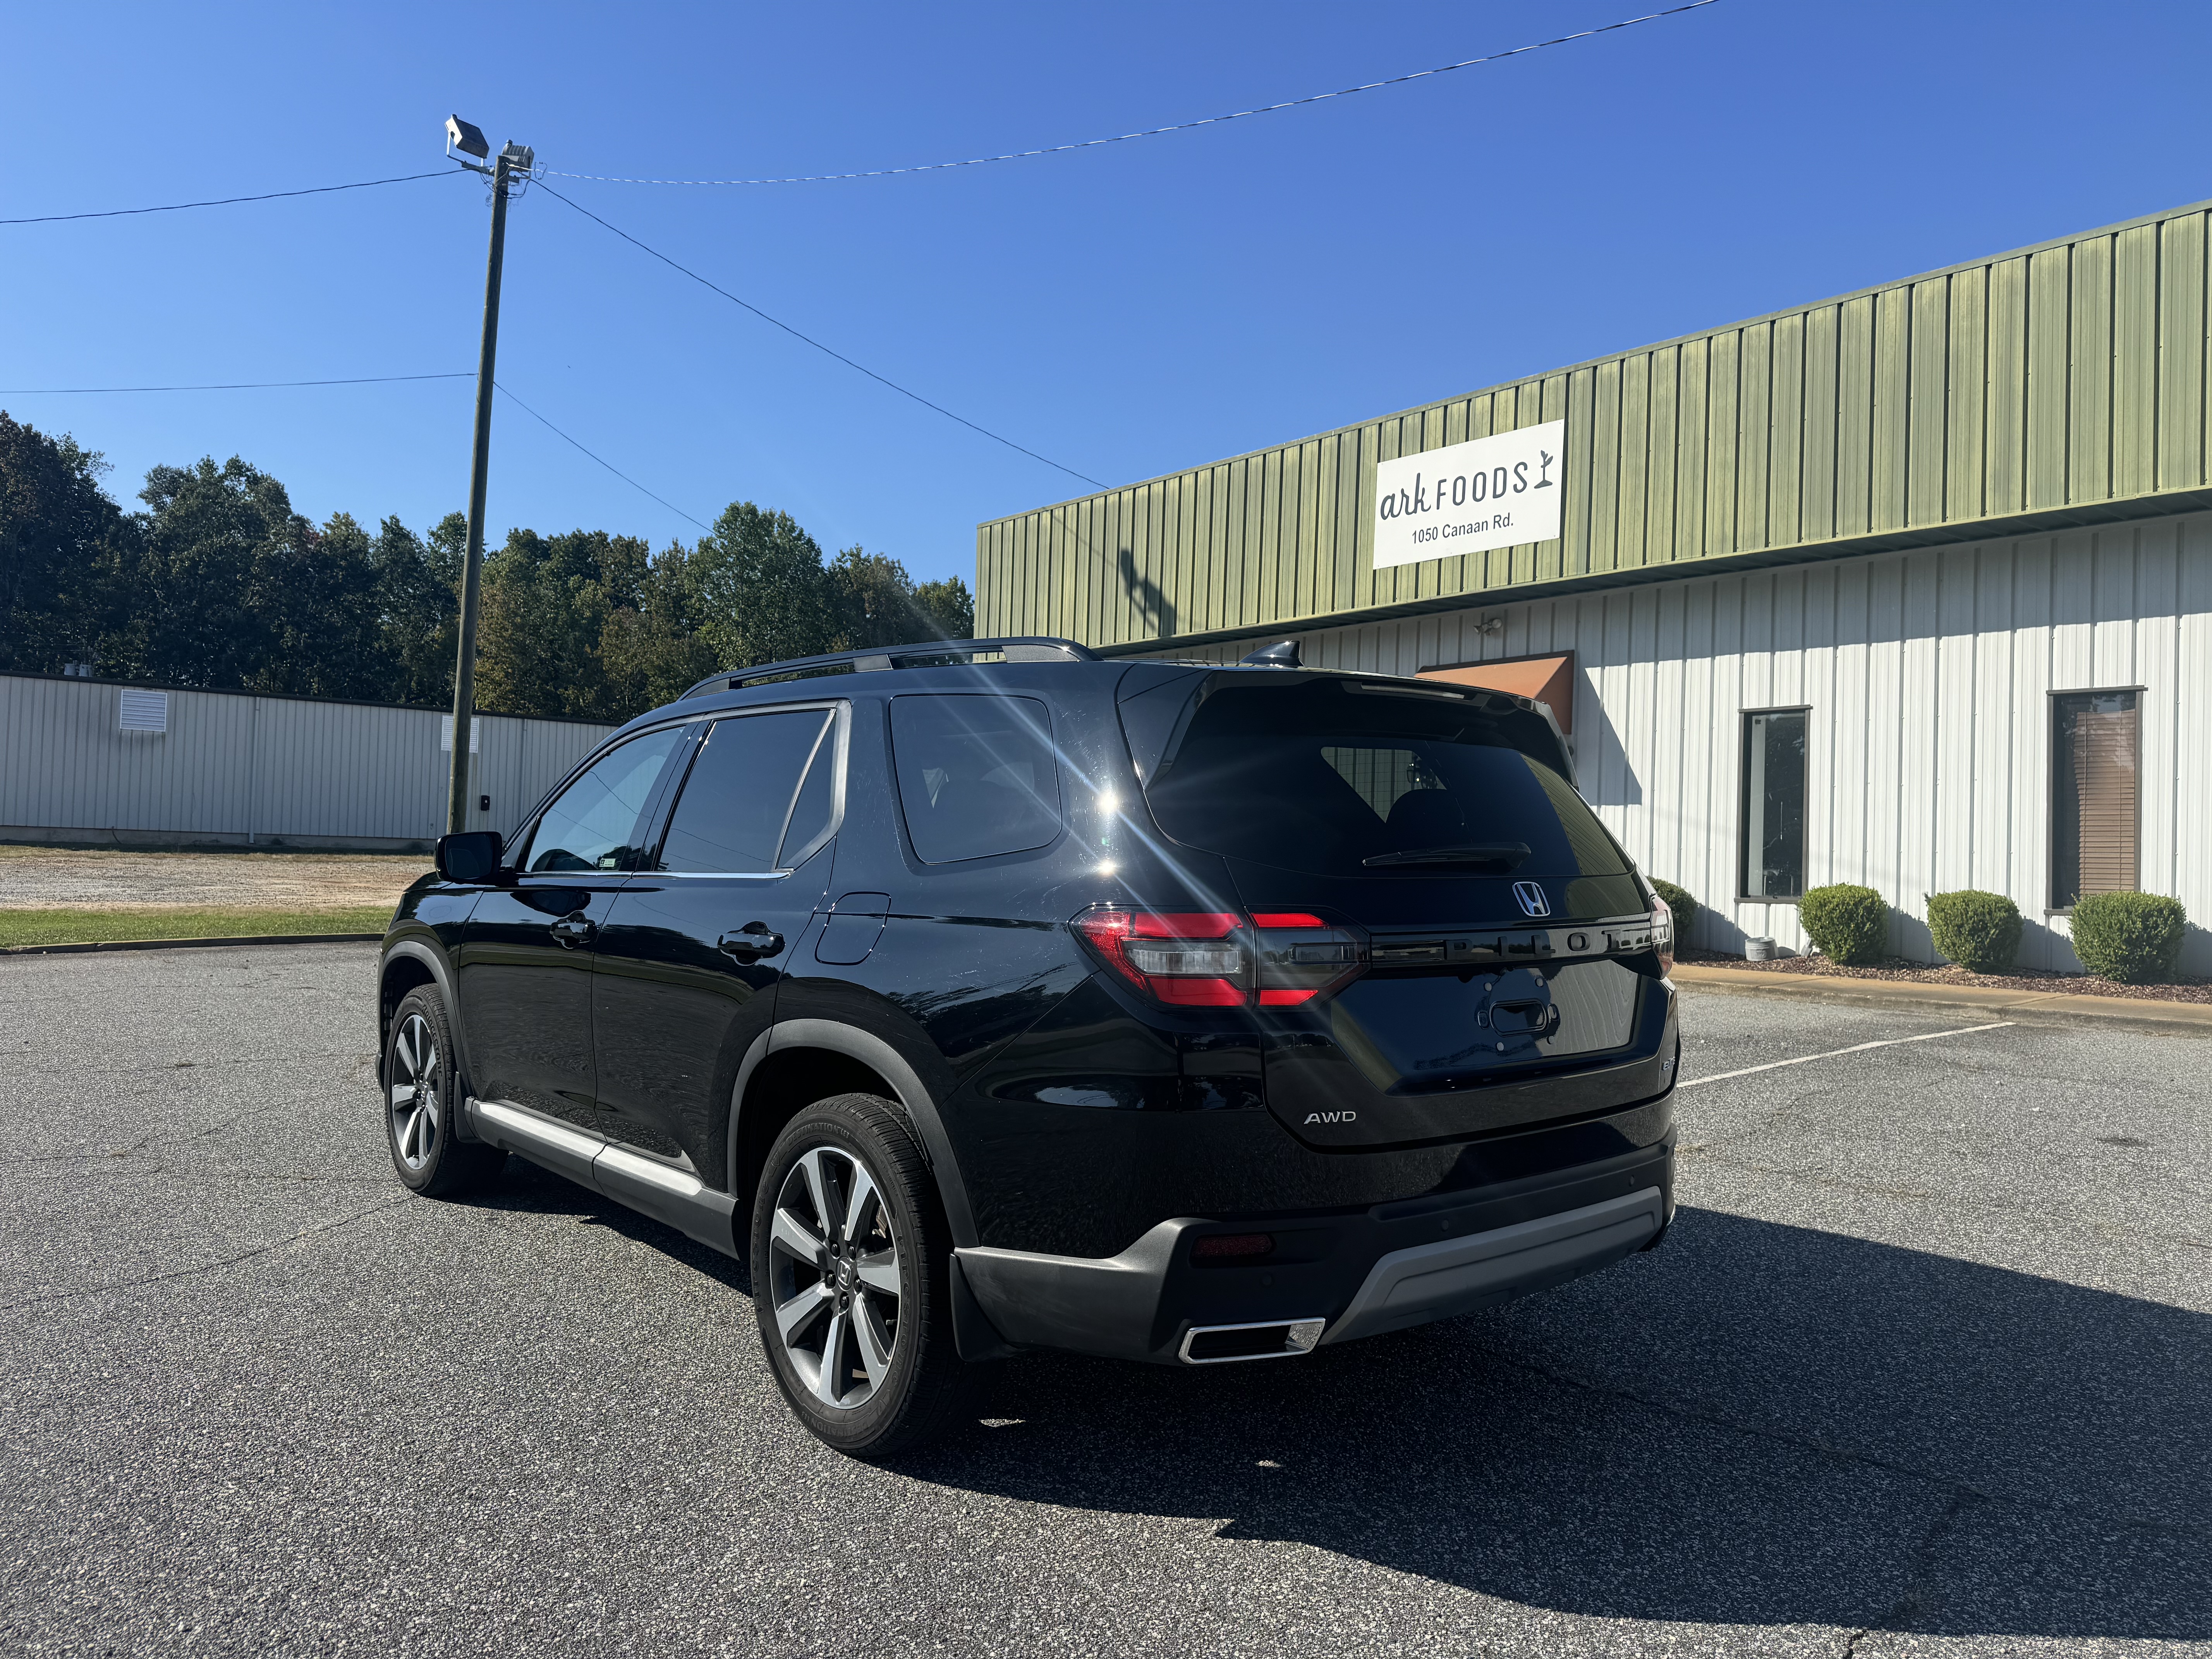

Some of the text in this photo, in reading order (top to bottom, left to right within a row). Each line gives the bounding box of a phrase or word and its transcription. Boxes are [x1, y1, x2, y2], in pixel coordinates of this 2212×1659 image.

[1380, 462, 1528, 520] ark FOODS
[1412, 512, 1514, 544] 1050 Canaan Rd.
[1443, 930, 1621, 960] PILOT
[1304, 1111, 1356, 1125] AWD
